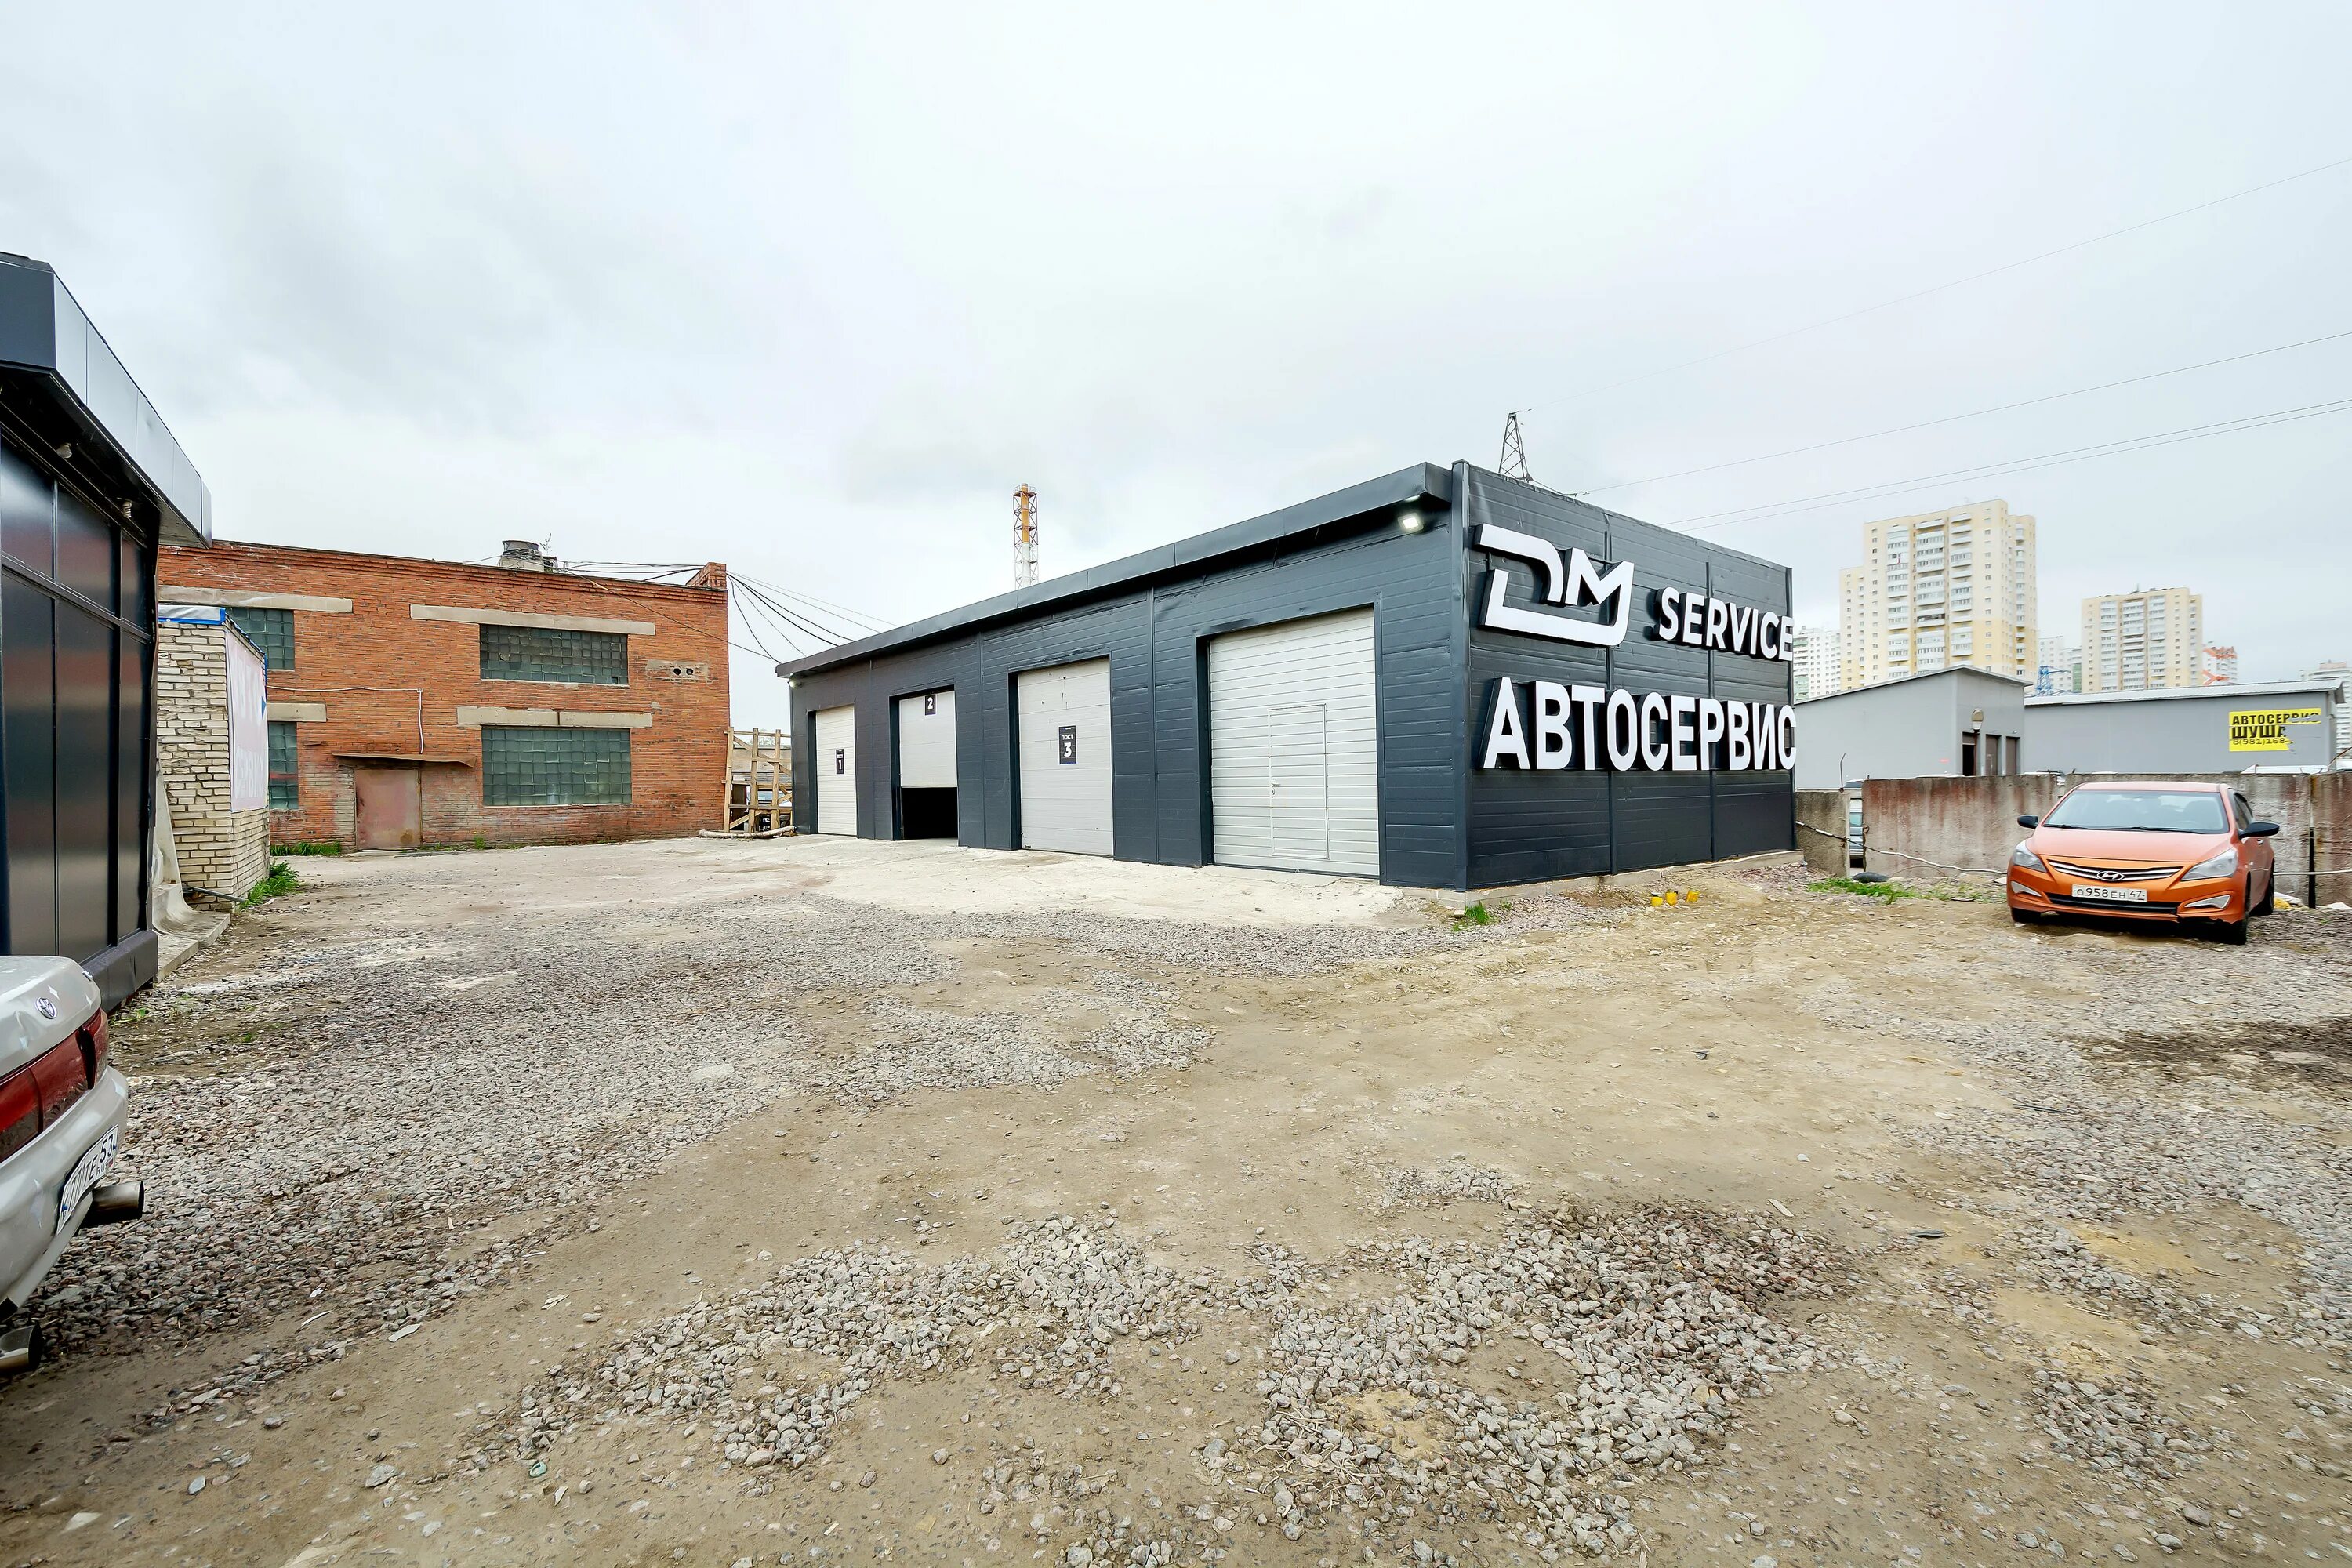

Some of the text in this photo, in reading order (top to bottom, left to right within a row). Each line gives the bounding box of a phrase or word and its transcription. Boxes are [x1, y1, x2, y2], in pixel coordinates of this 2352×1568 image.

[1659, 587, 1794, 662] SERVICE
[927, 697, 934, 710] 2
[1483, 677, 1797, 771] АВТОСЕРВИС
[1064, 742, 1072, 757] 3
[2077, 887, 2125, 898] О958ЕН
[100, 1133, 114, 1163] 53
